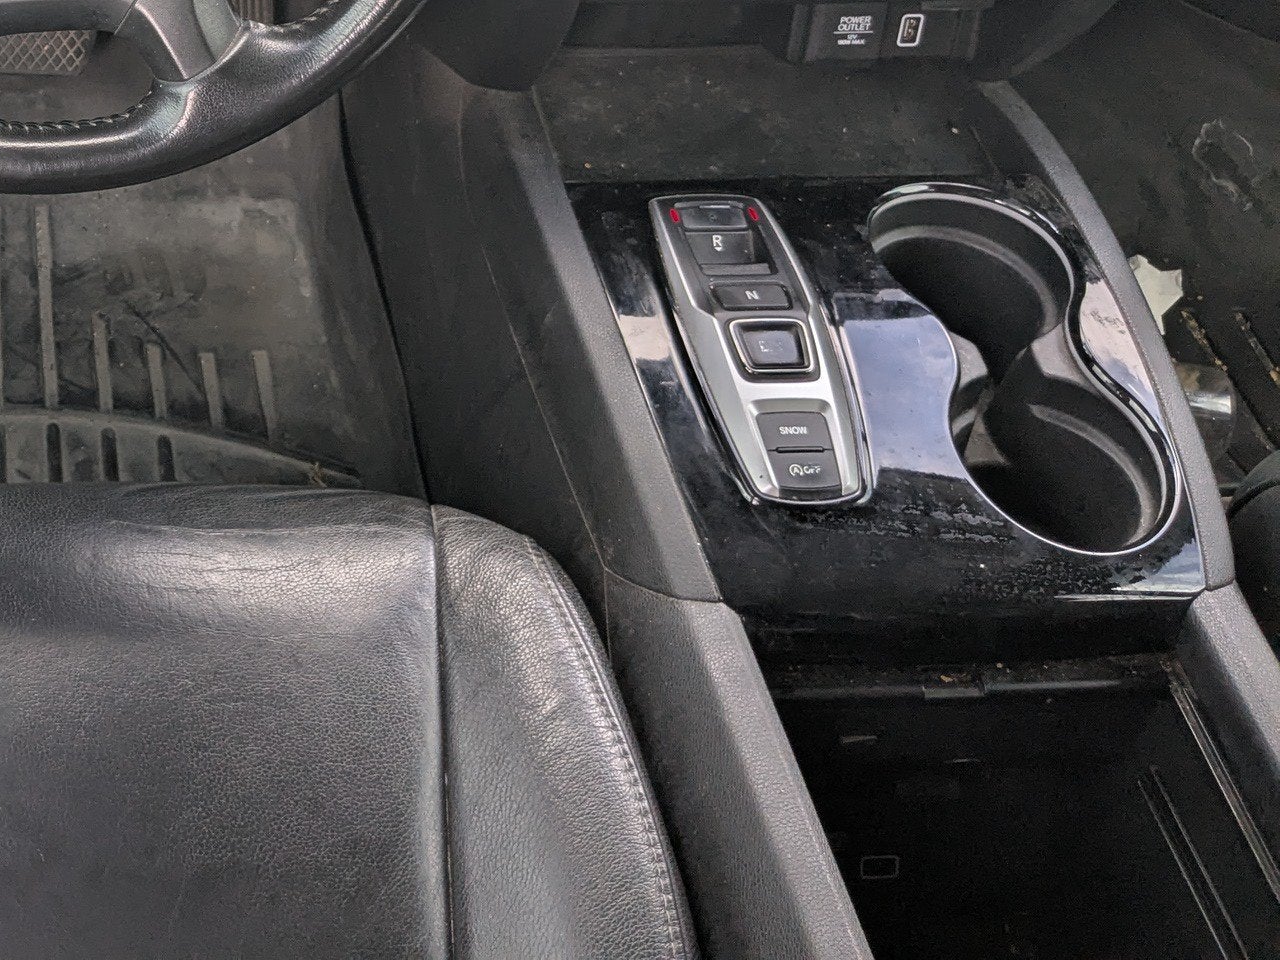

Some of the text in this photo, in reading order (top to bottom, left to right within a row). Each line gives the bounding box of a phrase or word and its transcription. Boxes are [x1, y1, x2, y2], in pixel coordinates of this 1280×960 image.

[840, 15, 872, 24] POWER
[837, 23, 871, 31] OUTLET
[712, 234, 722, 248] R
[745, 290, 760, 300] N
[779, 426, 808, 435] SNOW
